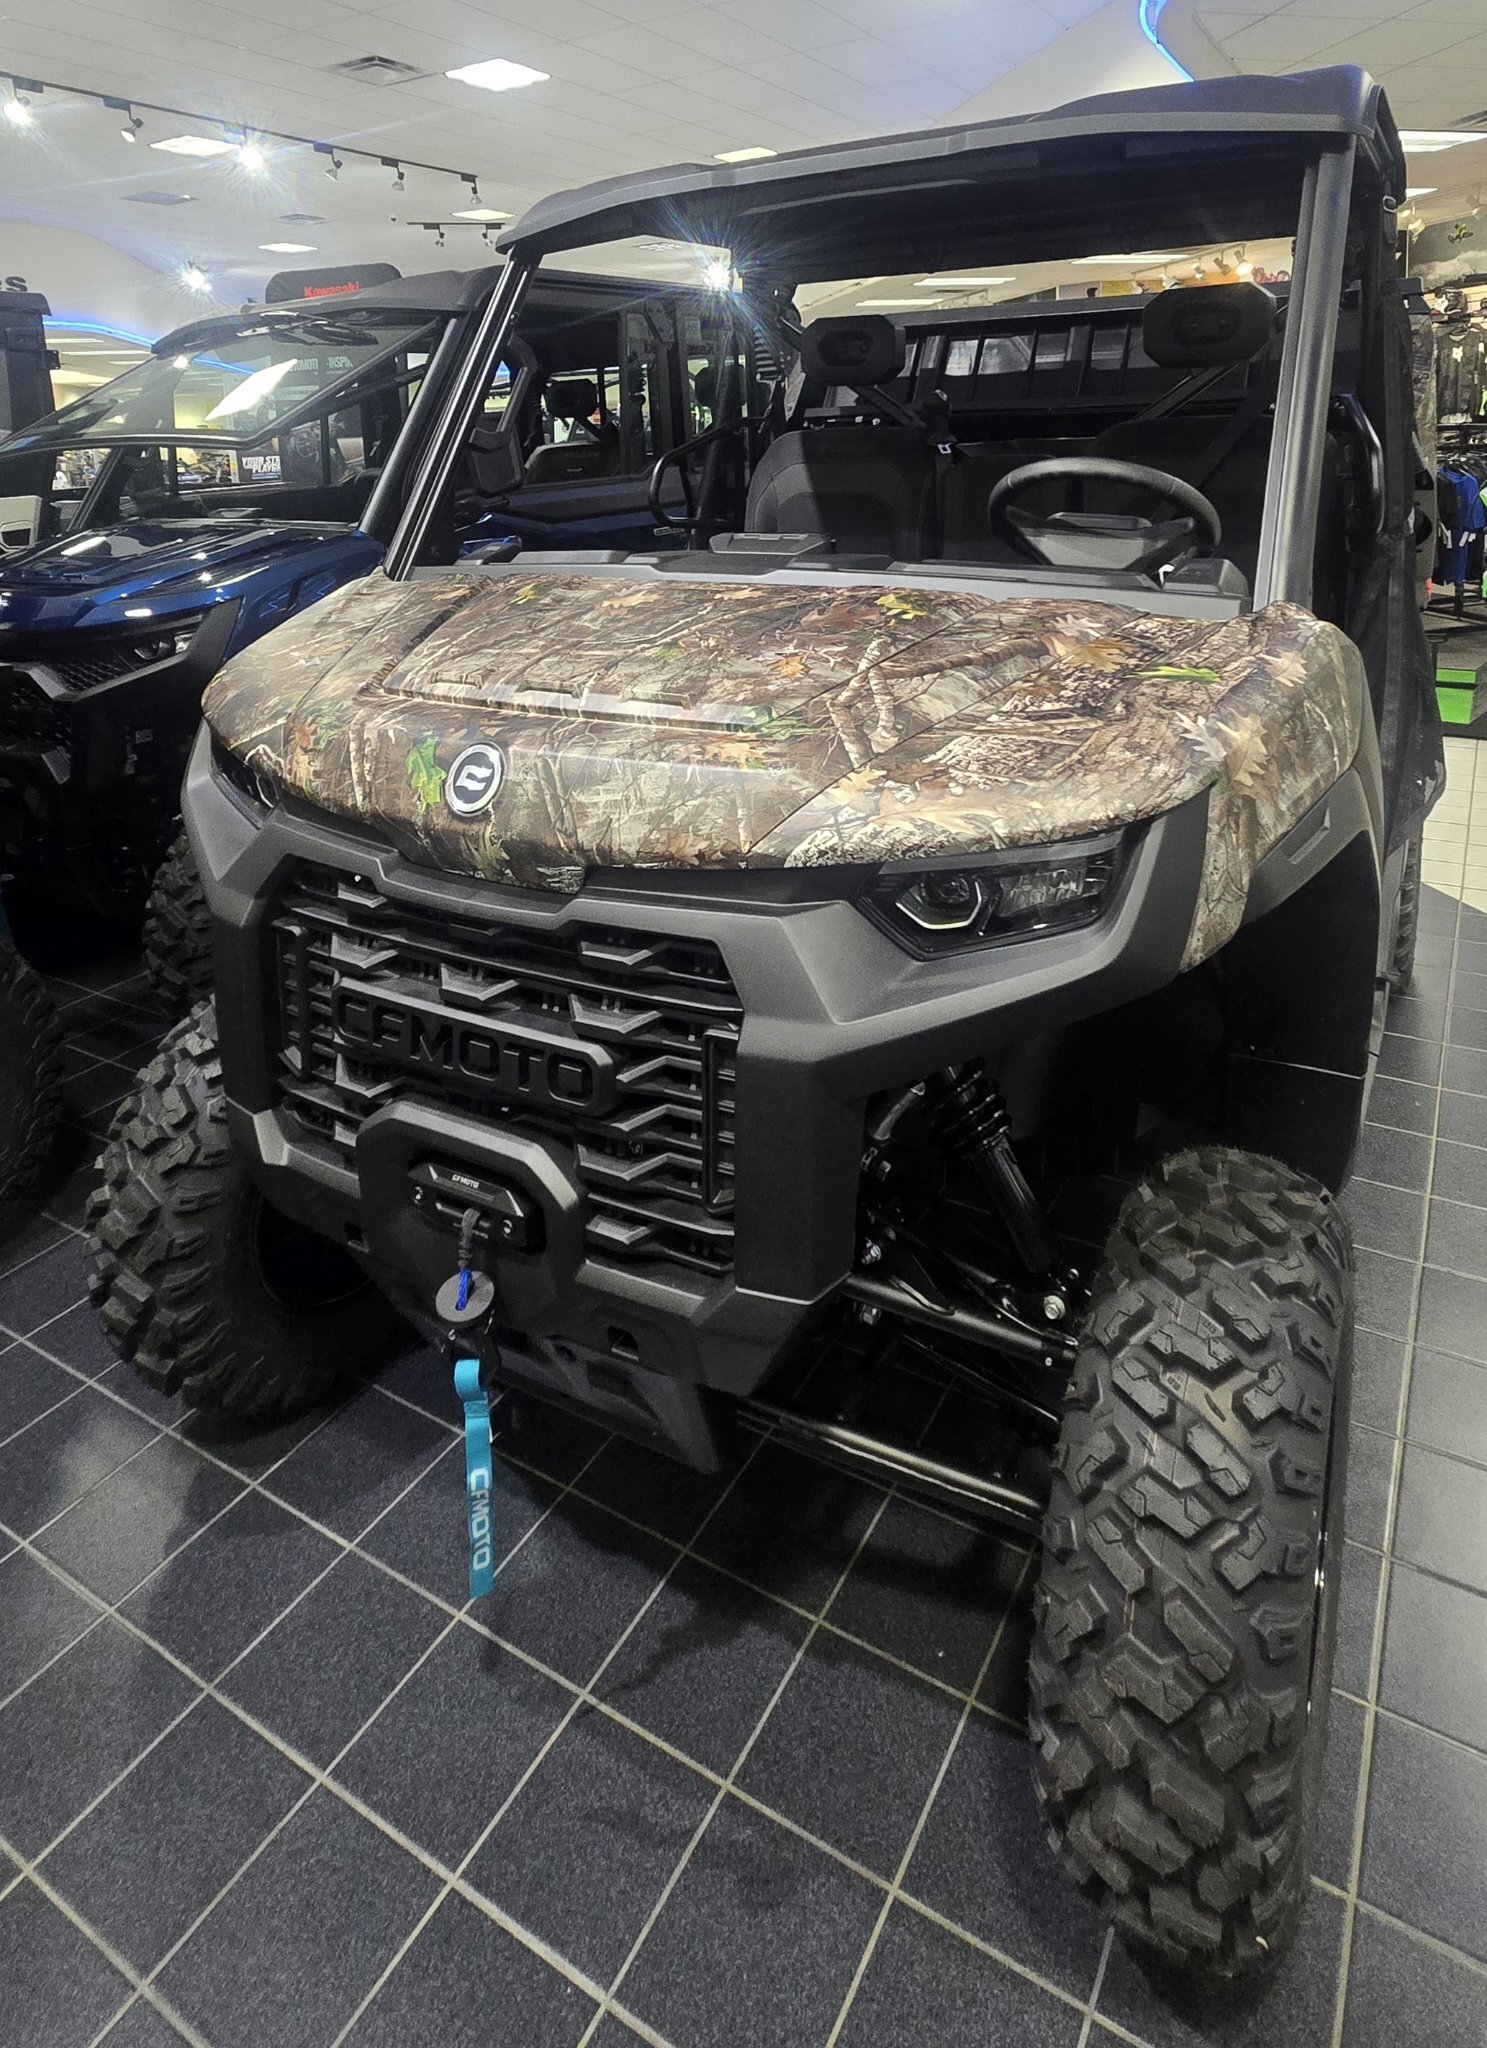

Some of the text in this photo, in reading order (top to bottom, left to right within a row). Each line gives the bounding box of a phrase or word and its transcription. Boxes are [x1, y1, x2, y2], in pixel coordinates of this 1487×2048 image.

[304, 281, 361, 298] Kawasaki
[242, 456, 264, 469] YOUR
[338, 994, 594, 1107] CFMOTO
[452, 1174, 480, 1189] CFMOTO
[470, 1467, 491, 1571] CFMOTO
